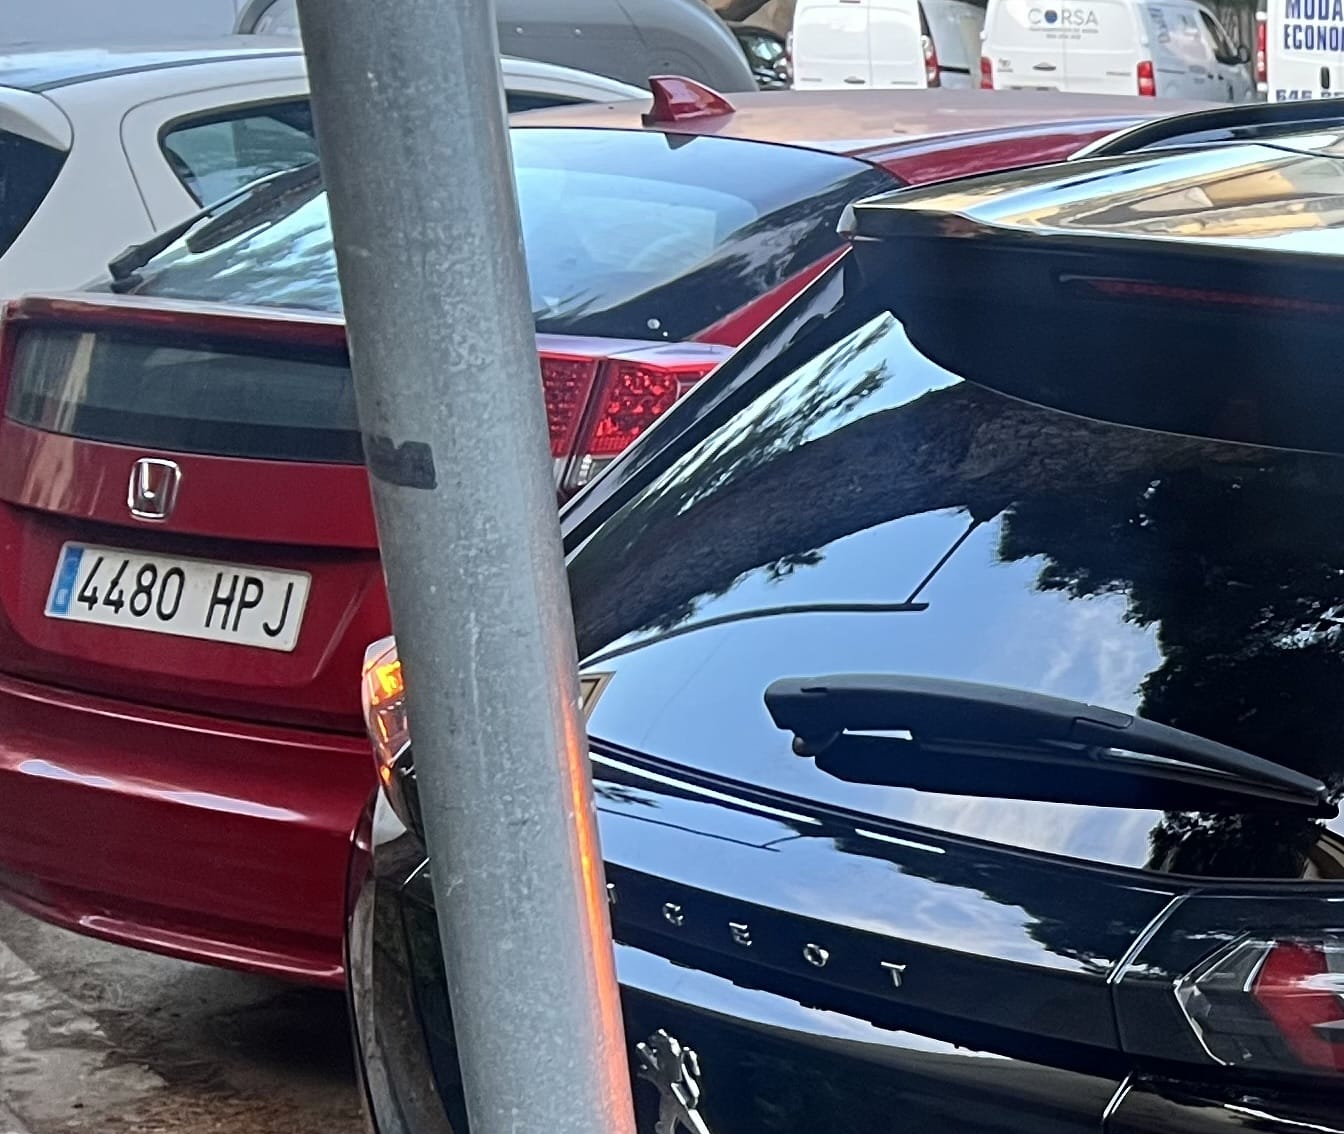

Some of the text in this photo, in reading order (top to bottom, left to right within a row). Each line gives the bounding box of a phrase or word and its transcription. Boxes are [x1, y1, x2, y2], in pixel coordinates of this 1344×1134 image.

[77, 556, 294, 637] 4480 HPJ
[606, 882, 906, 987] GEOT
